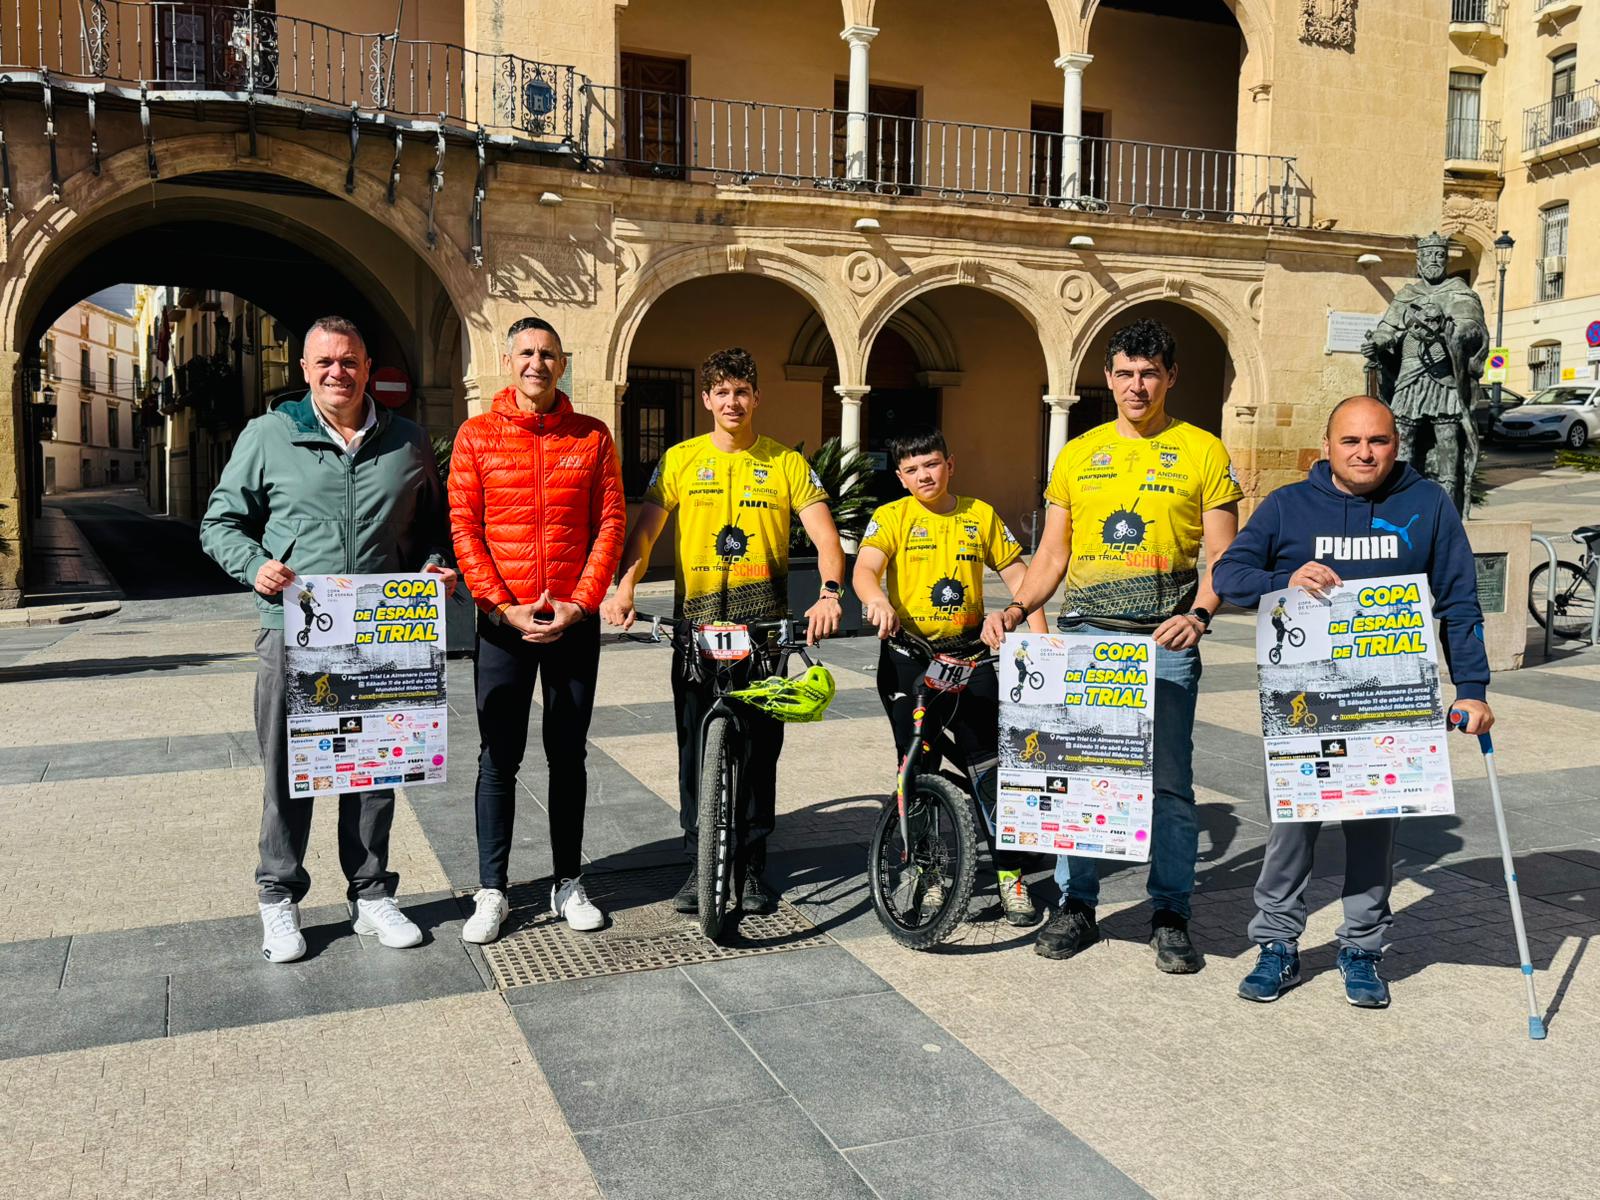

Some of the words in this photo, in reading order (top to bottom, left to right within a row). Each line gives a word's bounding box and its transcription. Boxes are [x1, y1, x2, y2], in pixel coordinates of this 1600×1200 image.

[1314, 535, 1399, 560] PUMA
[384, 580, 437, 598] COPA
[1358, 583, 1420, 607] COPA
[355, 611, 372, 621] DE
[375, 602, 437, 621] ESPAÑA
[1329, 620, 1349, 635] DE
[1352, 609, 1424, 633] ESPAÑA
[356, 633, 372, 644] DE
[376, 623, 438, 643] TRIAL
[714, 632, 732, 650] 11
[1094, 642, 1149, 661] COPA
[1332, 645, 1352, 660] DE
[1355, 632, 1427, 657] TRIAL
[938, 663, 964, 684] 119
[1064, 671, 1082, 683] DE
[1085, 666, 1147, 685] ESPAÑA
[1065, 693, 1082, 705] DE
[1085, 687, 1147, 708] TRIAL
[1326, 692, 1350, 700] Parque
[1375, 689, 1406, 697] Almenara
[1408, 686, 1430, 695] (Lorca)
[1358, 704, 1393, 712] Mundobici
[1416, 701, 1431, 709] Club
